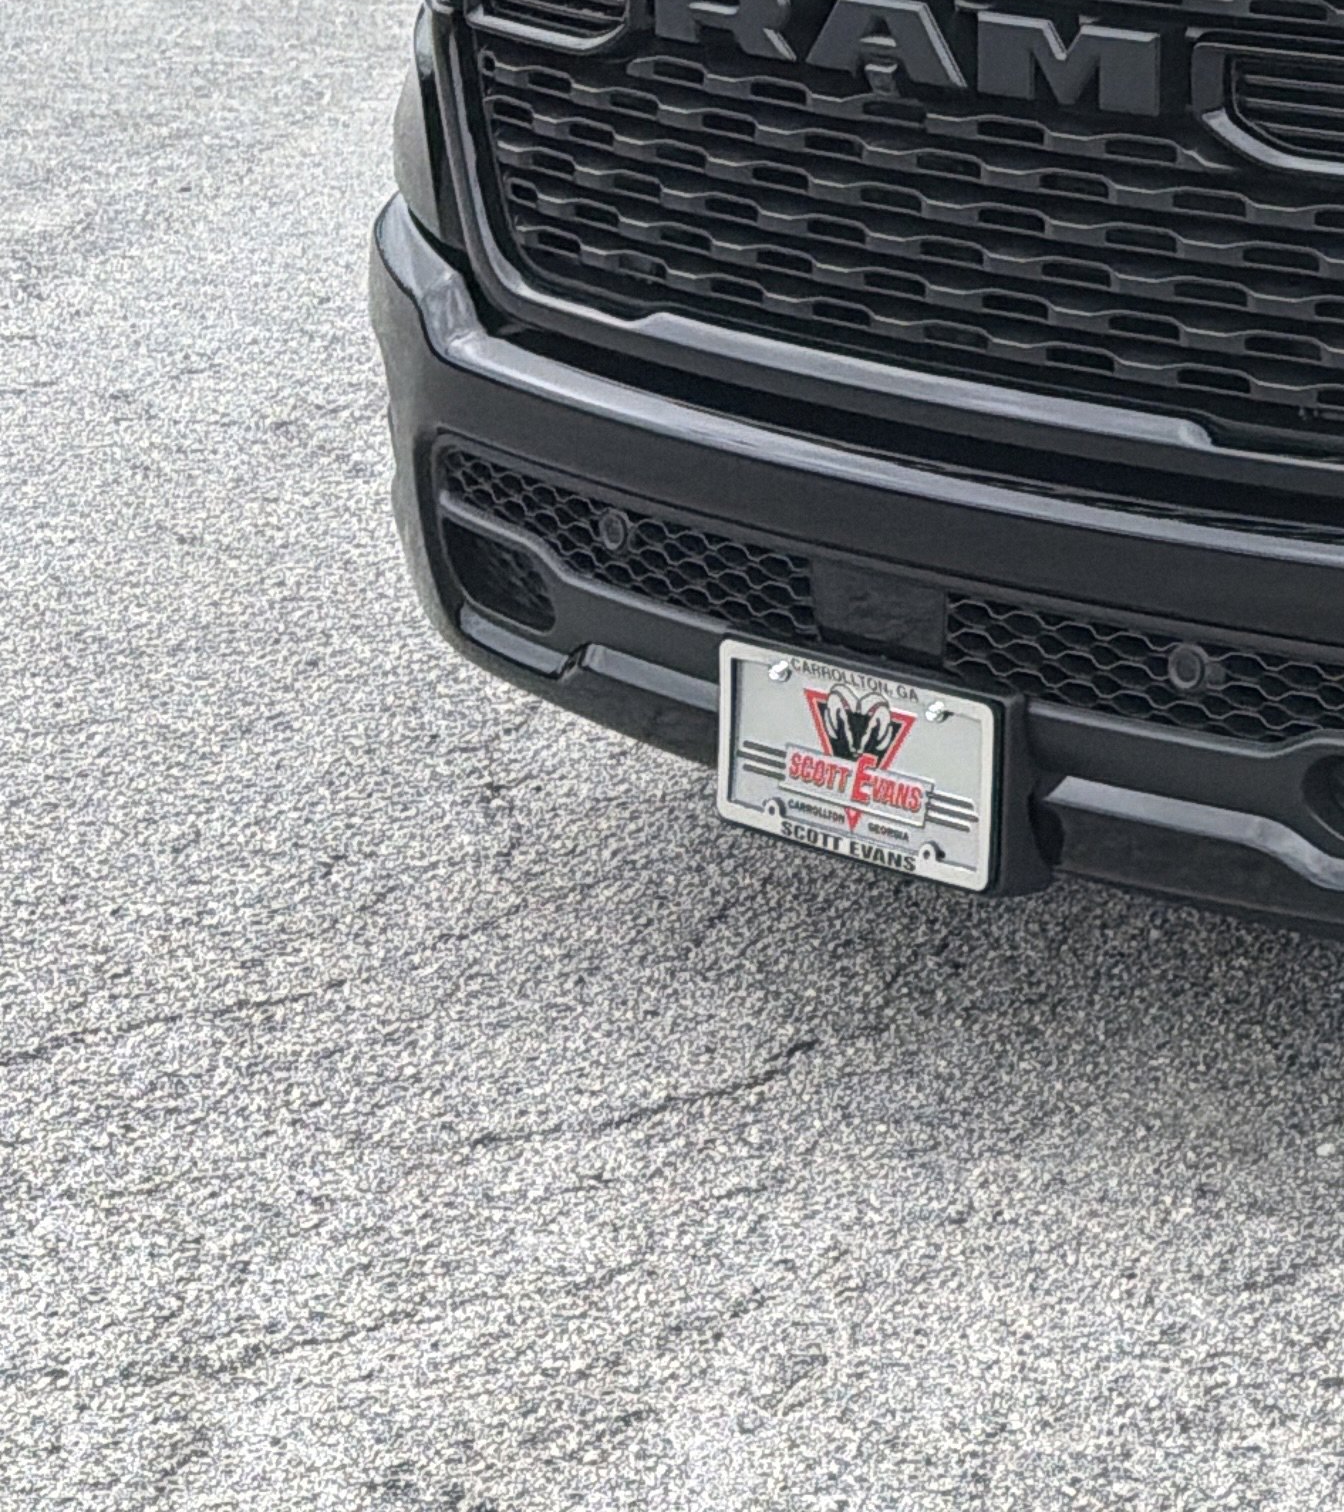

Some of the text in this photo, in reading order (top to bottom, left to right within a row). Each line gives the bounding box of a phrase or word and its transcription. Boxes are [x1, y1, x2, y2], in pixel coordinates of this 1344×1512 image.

[790, 657, 919, 703] CARROLLTON, GA
[789, 752, 924, 814] SCOTT EVANS
[780, 821, 917, 872] SCOTT EVANS
